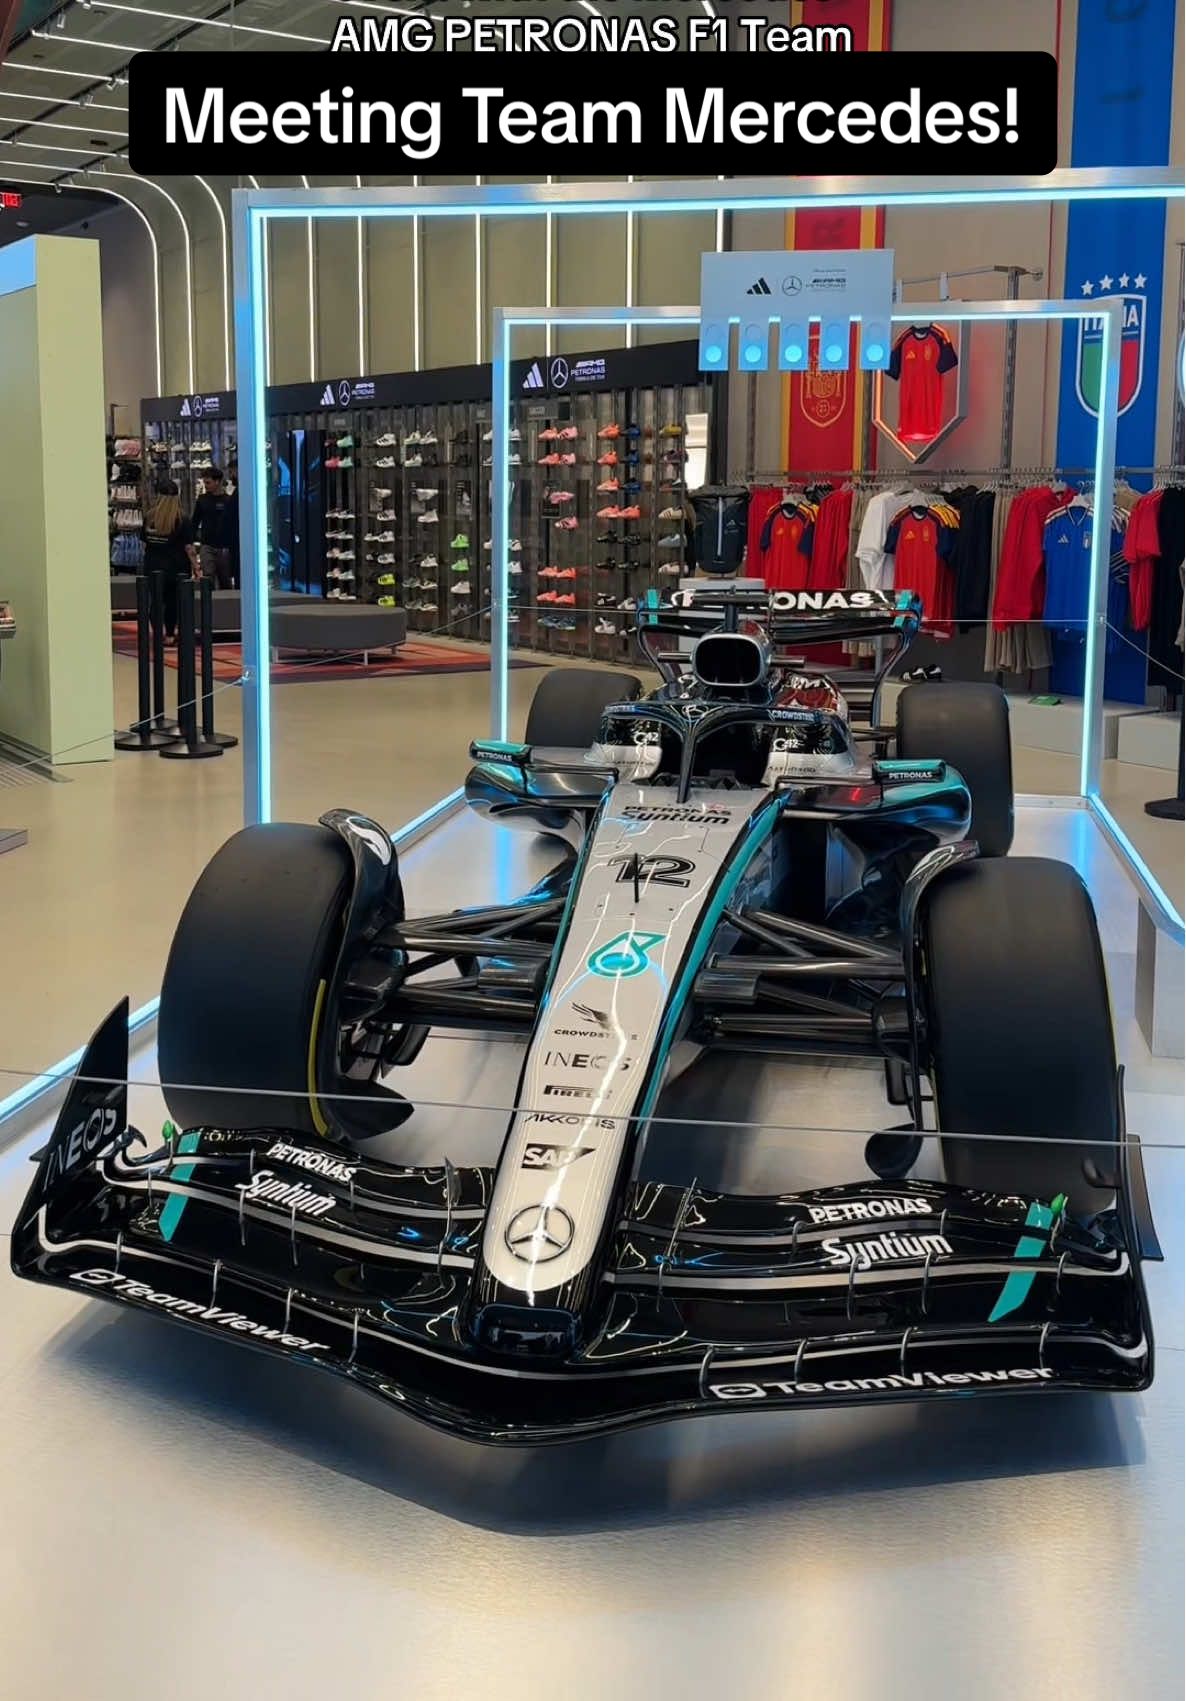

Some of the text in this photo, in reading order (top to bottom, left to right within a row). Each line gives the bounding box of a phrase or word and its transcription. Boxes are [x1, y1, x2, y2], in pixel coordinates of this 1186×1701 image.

[477, 751, 513, 762] PETRONAS
[888, 771, 934, 779] PETRONAS
[624, 806, 732, 816] PETRONAS
[607, 853, 696, 889] 12
[265, 1142, 357, 1183] PETRONAS
[234, 1169, 337, 1216] Syntium
[808, 1197, 933, 1224] PETRONAS
[821, 1231, 954, 1271] Syntium
[111, 1278, 331, 1351] TeamViewer
[763, 1365, 1054, 1395] TeamViewer
